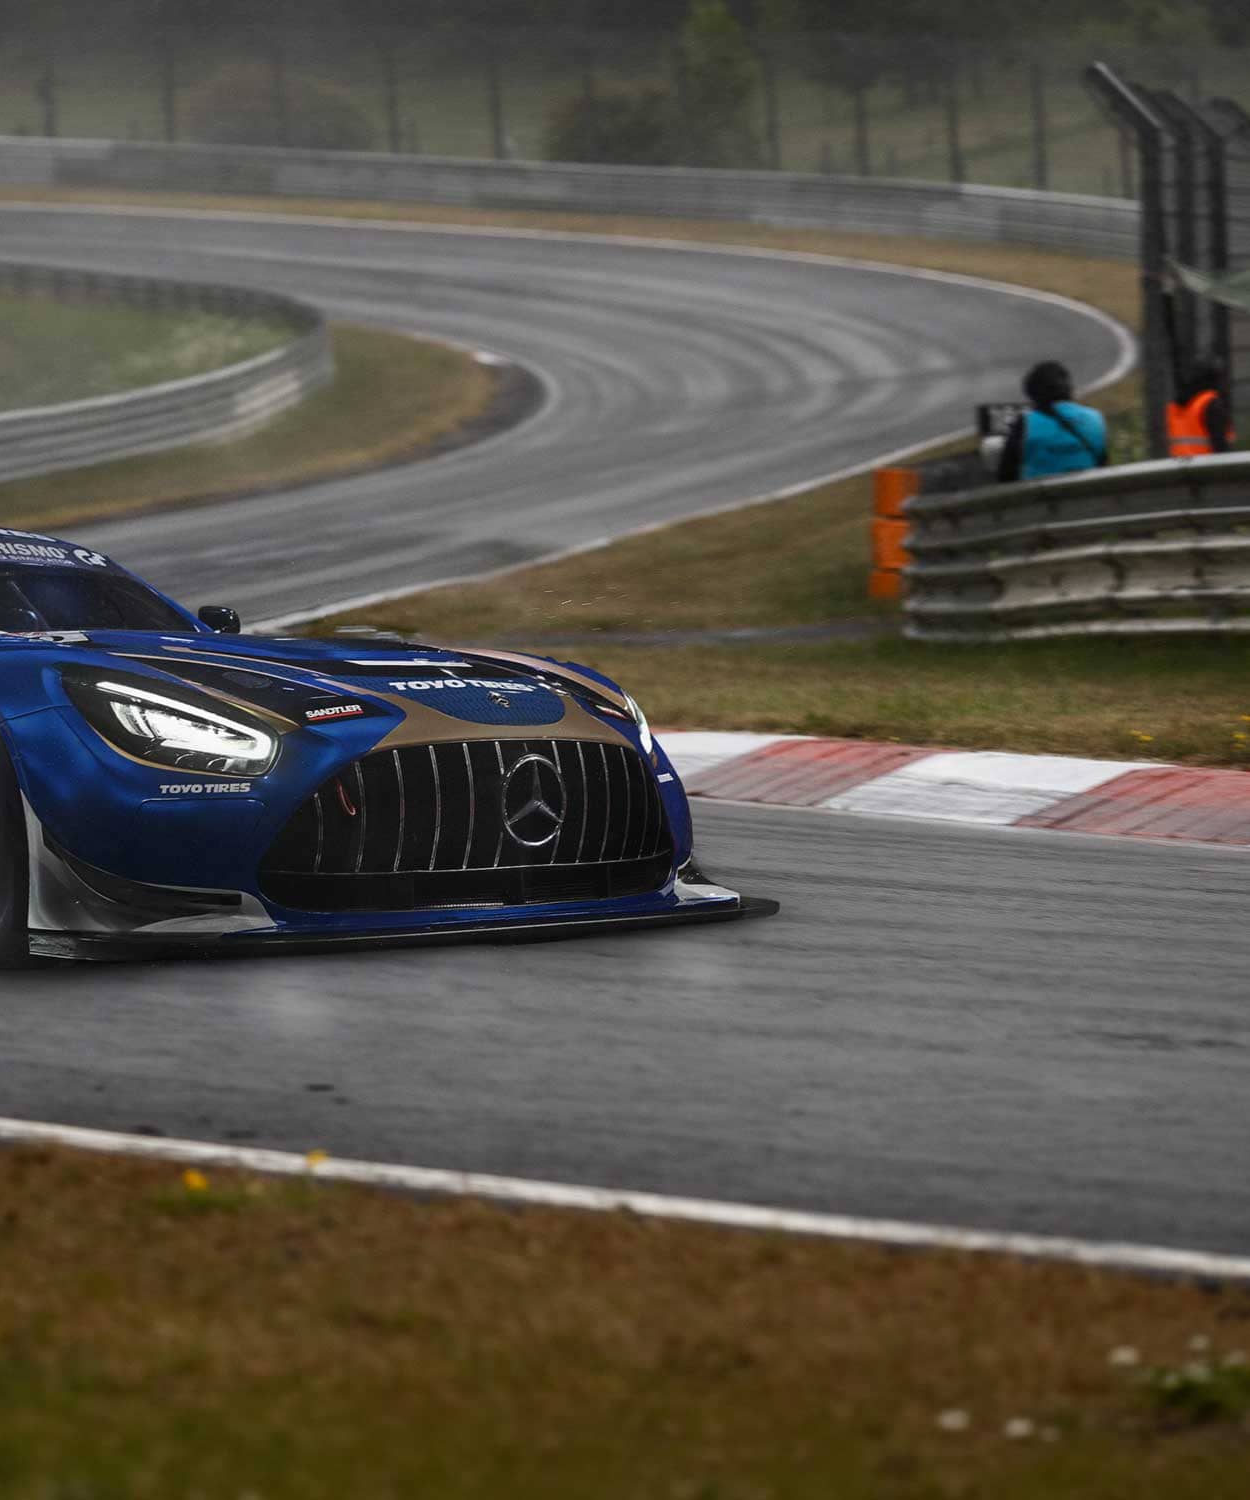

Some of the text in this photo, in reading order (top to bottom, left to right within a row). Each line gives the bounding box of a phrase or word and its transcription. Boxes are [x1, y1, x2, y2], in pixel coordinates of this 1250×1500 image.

[389, 679, 467, 691] TOYO
[305, 704, 362, 718] SANDTLER
[159, 782, 251, 794] TOYO TIRES
